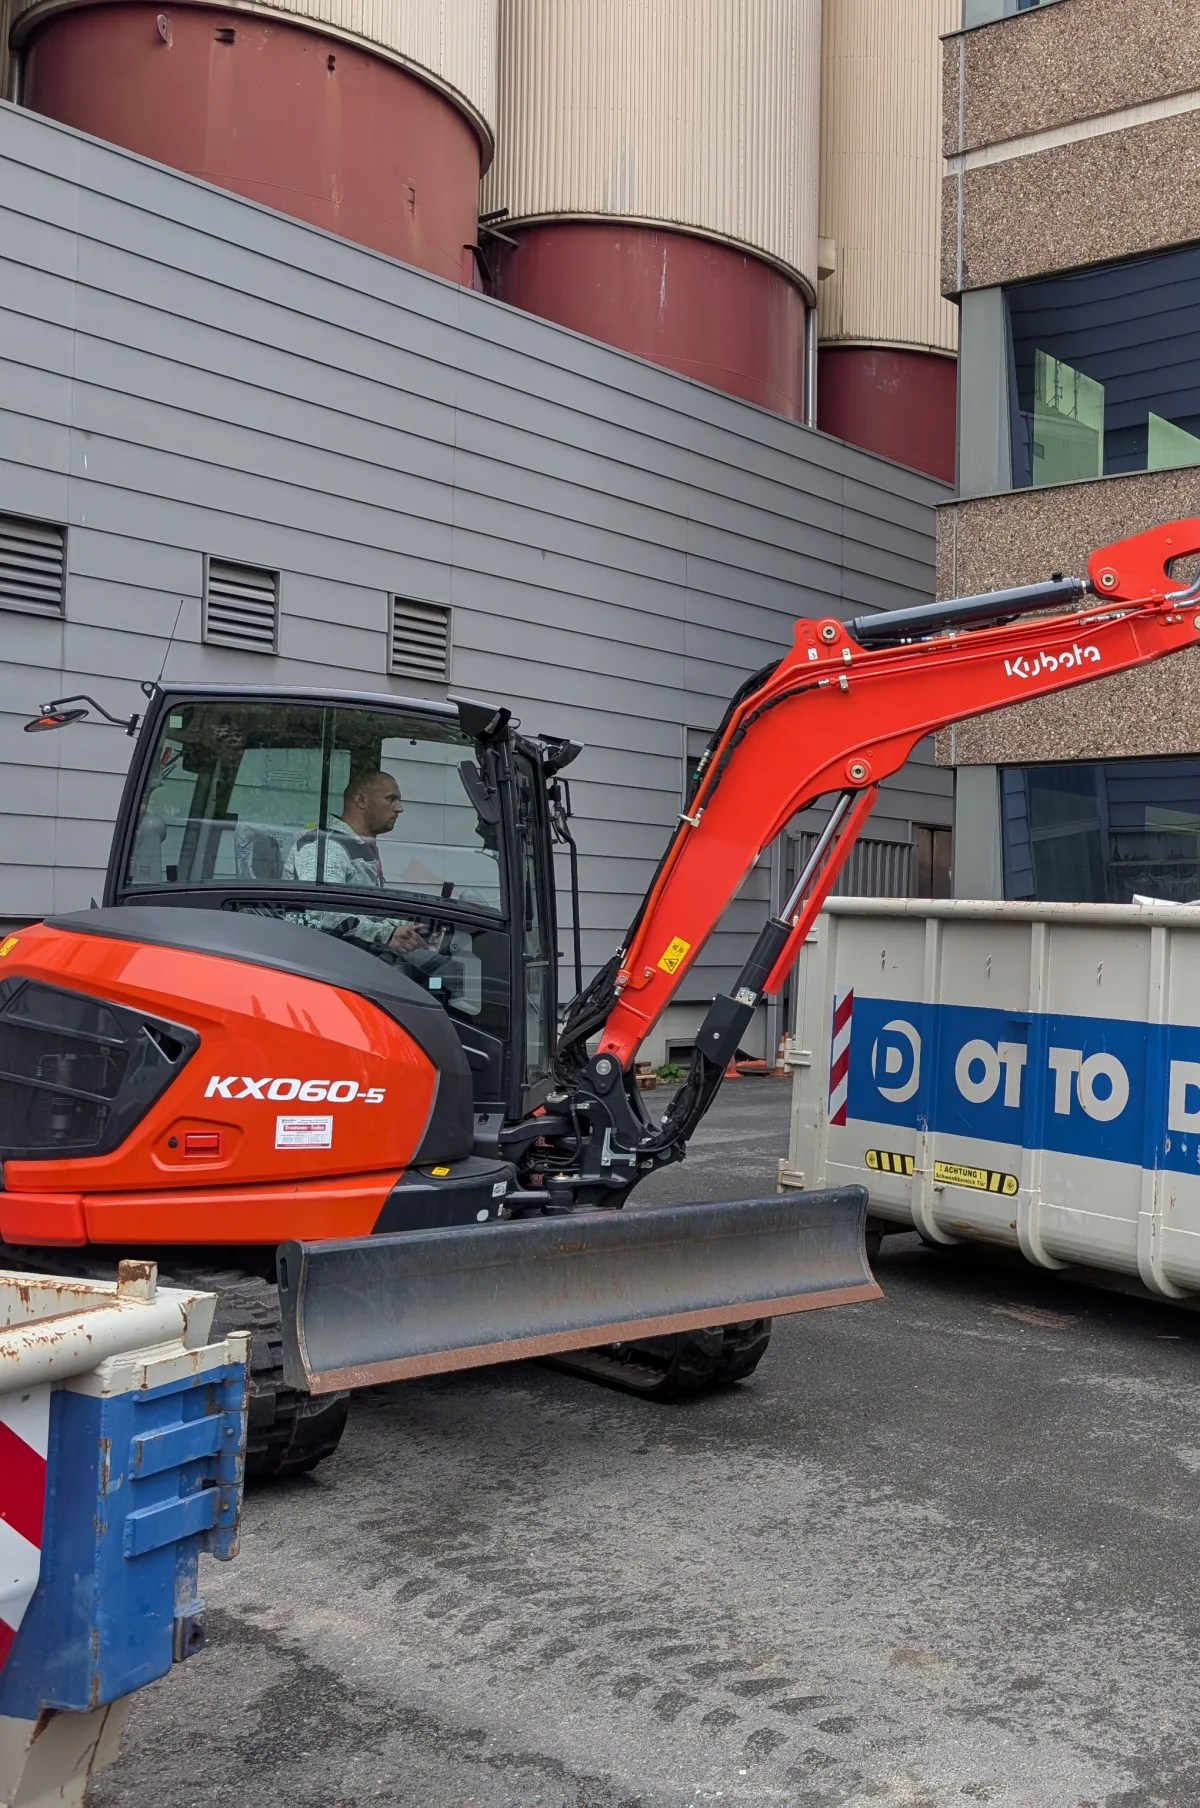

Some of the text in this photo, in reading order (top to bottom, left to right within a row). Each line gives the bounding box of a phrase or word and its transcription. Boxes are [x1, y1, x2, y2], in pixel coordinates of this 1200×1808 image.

[1003, 643, 1101, 679] Kubota
[203, 1076, 386, 1104] KX060-5
[955, 1039, 1130, 1122] OTTO
[935, 1172, 976, 1185] Schwenkbereich
[944, 1165, 978, 1179] ACHTUNG
